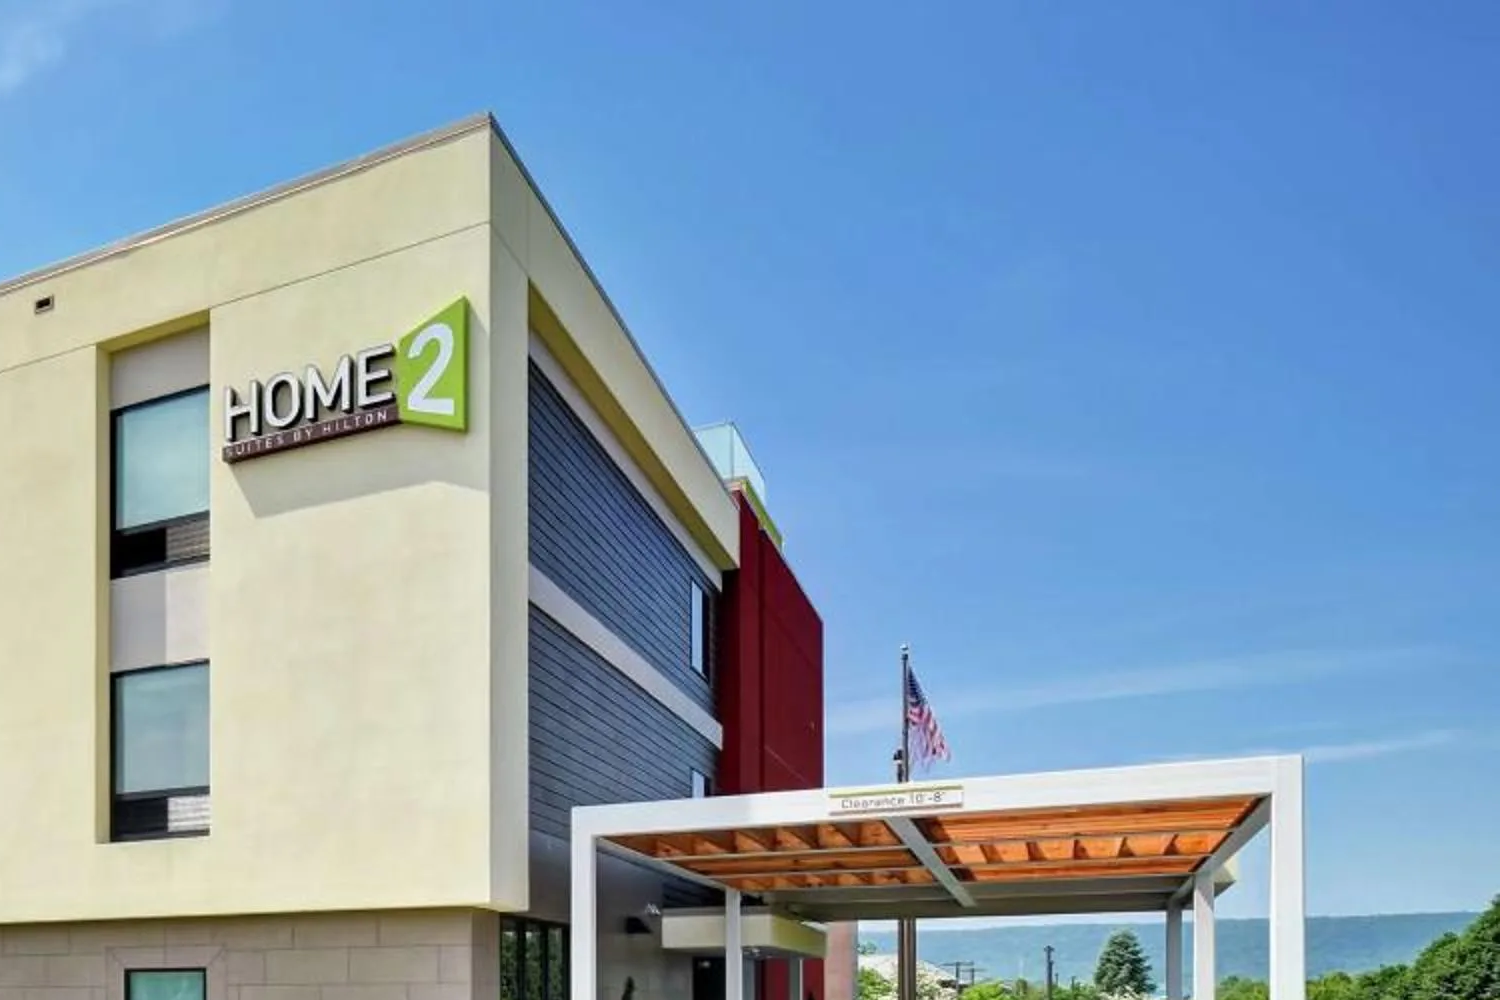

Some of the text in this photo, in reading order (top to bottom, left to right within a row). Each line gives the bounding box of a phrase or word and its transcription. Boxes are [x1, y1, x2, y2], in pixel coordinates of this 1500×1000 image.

[225, 322, 455, 442] HOME 2
[226, 409, 388, 458] SUITES BY HILTON
[841, 797, 905, 809] Clearance
